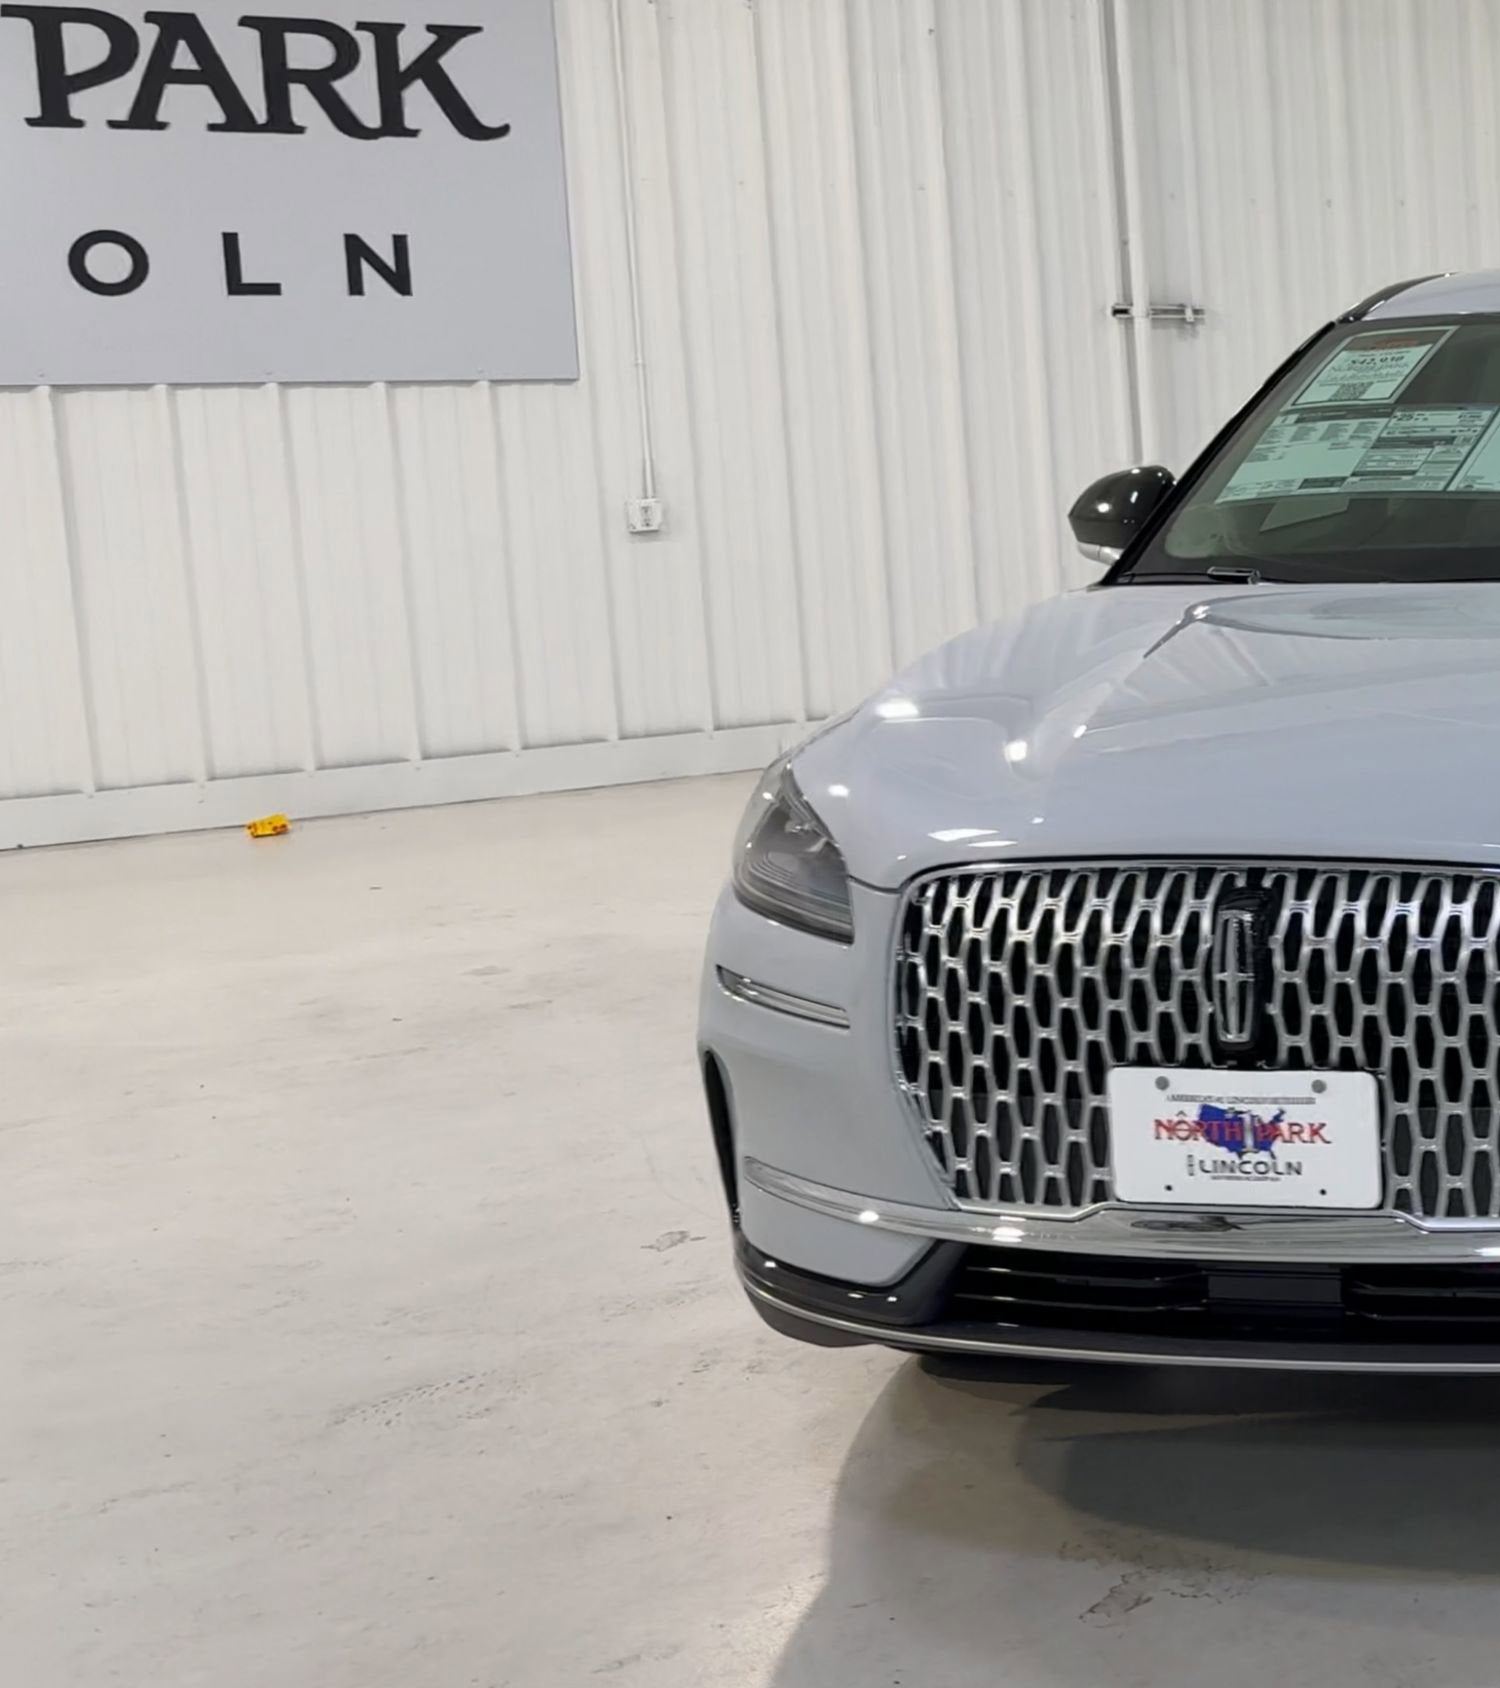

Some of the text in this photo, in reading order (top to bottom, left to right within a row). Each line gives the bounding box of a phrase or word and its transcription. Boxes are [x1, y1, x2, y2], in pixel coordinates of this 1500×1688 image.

[0, 4, 511, 141] PARK
[1255, 1121, 1332, 1144] PARK
[1199, 1160, 1302, 1176] LINCOLN
